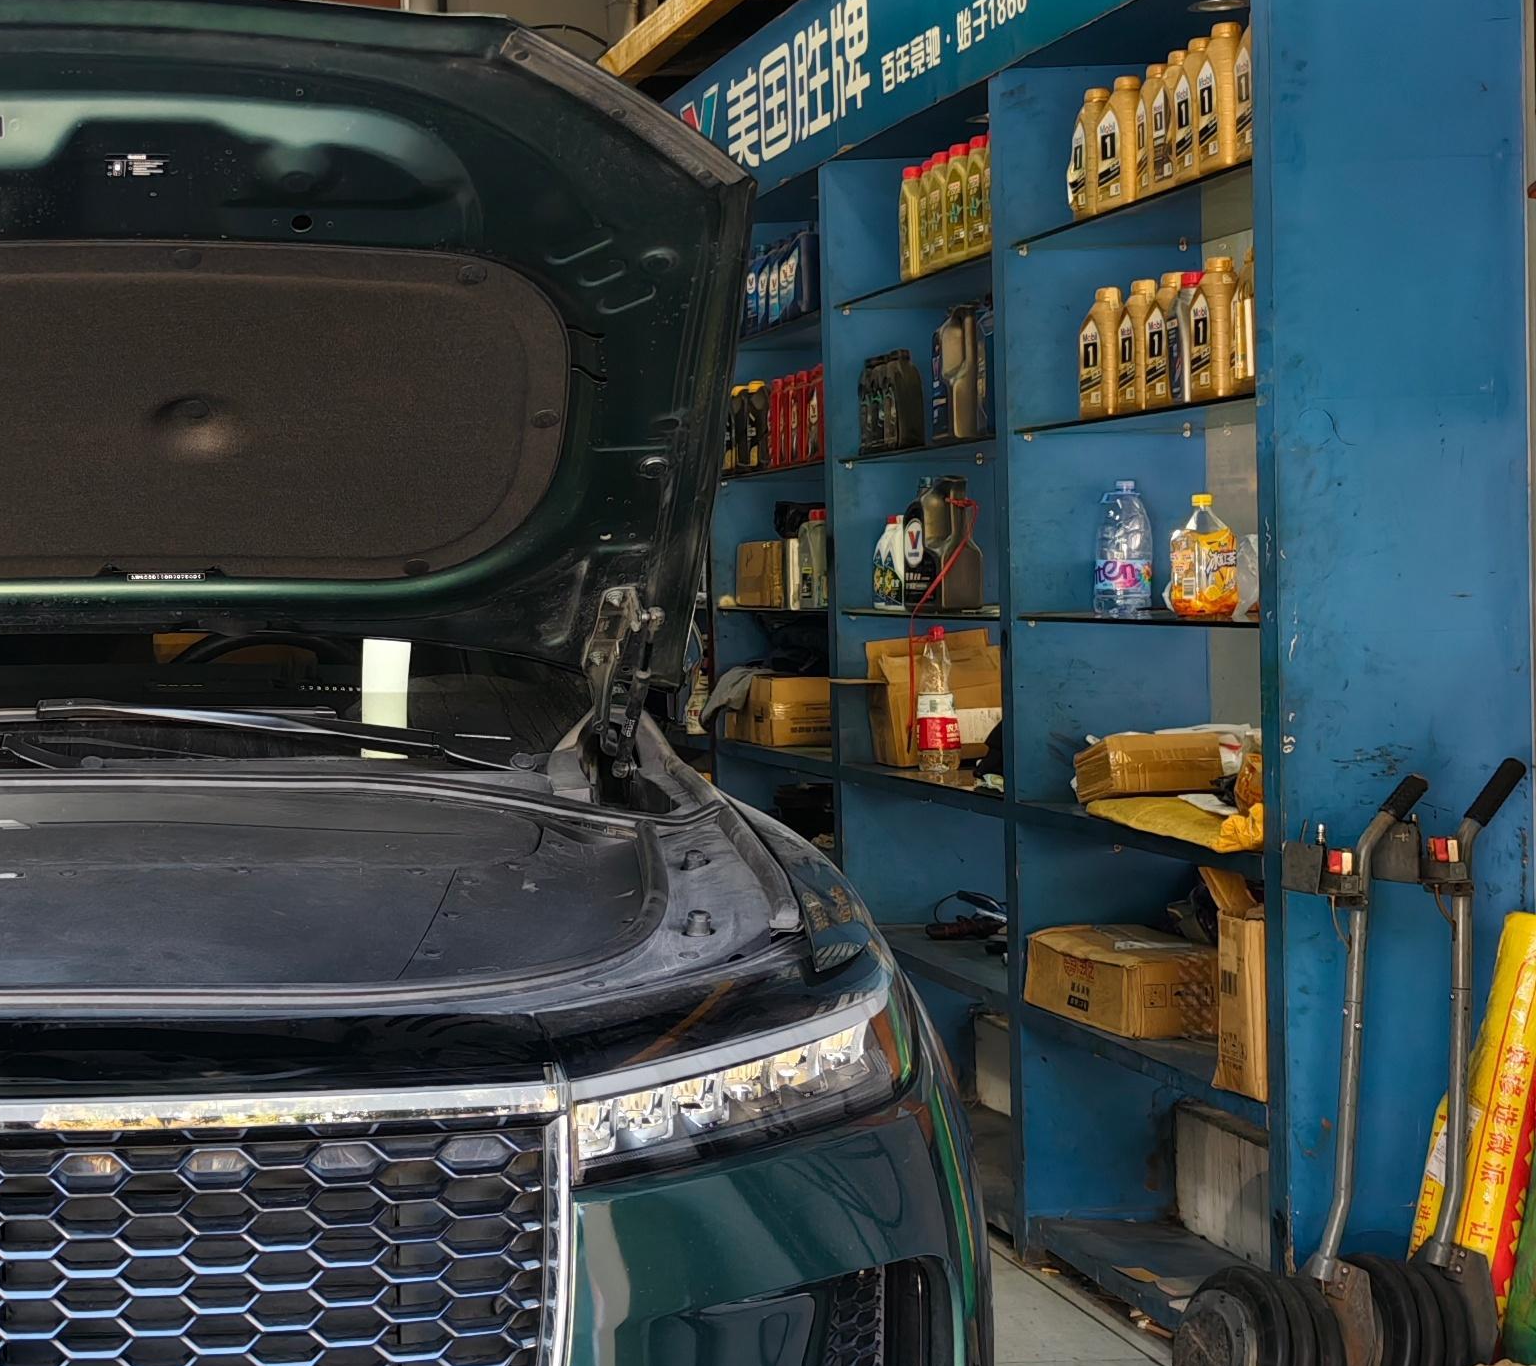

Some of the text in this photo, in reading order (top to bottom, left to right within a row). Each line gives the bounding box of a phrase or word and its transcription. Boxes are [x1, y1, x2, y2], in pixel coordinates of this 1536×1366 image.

[1193, 306, 1207, 319] Mobil
[1148, 319, 1163, 331] Mobil
[1082, 332, 1098, 343] Mobil
